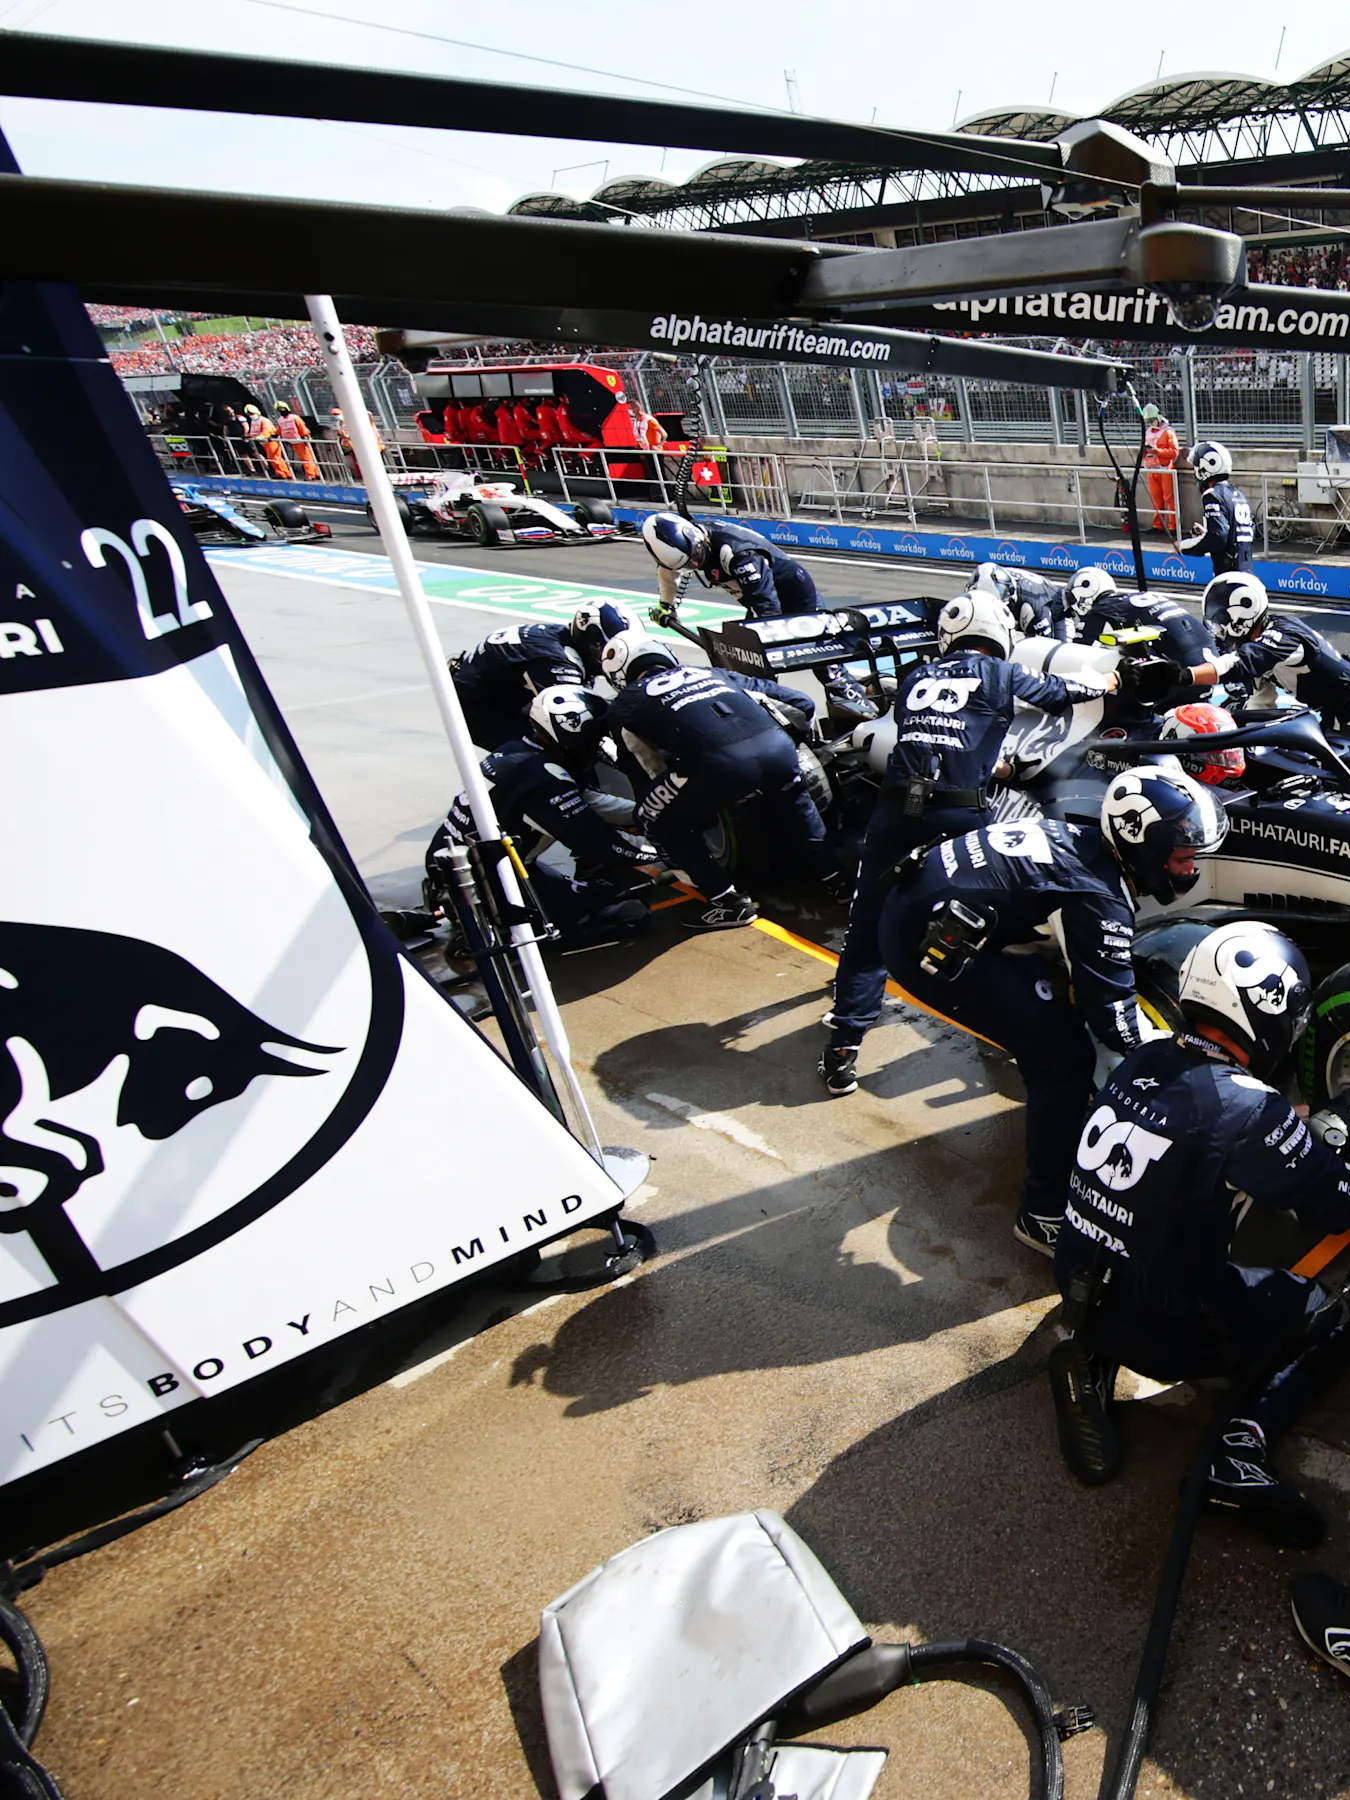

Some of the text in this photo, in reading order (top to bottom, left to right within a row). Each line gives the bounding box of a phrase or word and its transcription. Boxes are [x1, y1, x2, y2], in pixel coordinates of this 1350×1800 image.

[649, 313, 892, 362] alphataurif1team.com
[80, 518, 214, 641] 22
[892, 630, 935, 642] ASHION
[899, 731, 965, 749] HONDA
[903, 715, 966, 731] ALPHATAURI
[1108, 1081, 1168, 1126] SCUDERIA
[1069, 1168, 1134, 1227] LPHATAURI
